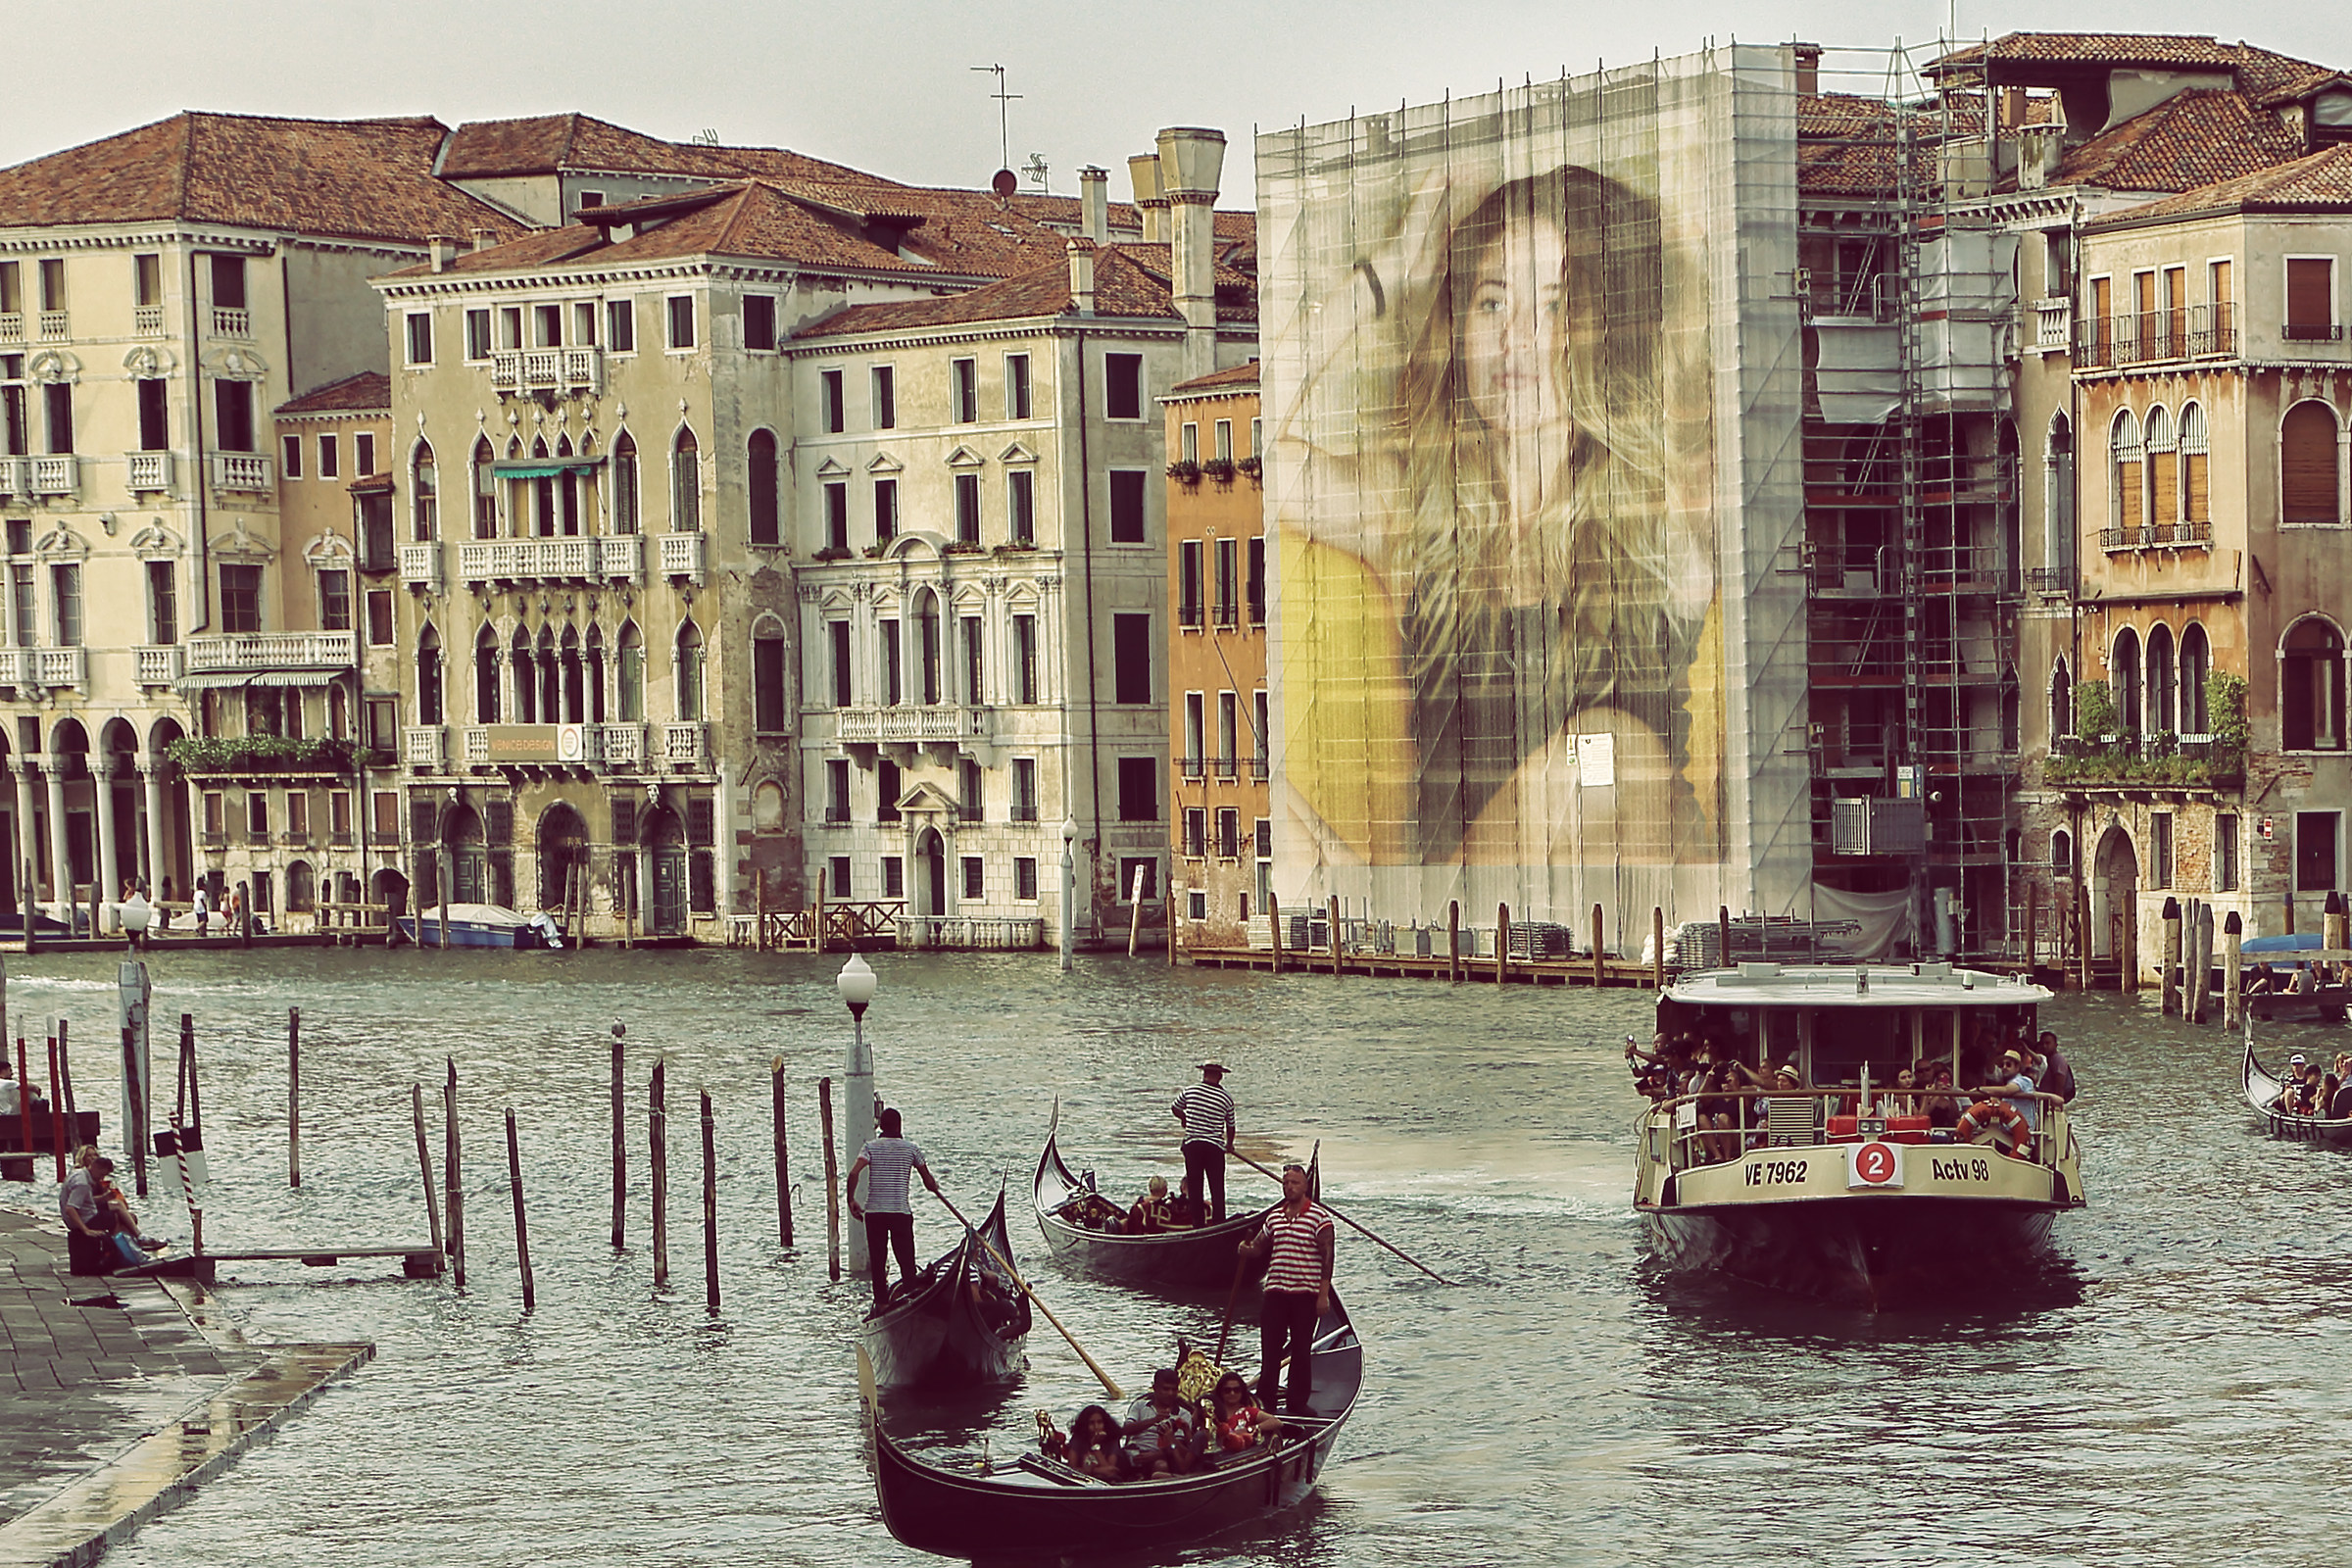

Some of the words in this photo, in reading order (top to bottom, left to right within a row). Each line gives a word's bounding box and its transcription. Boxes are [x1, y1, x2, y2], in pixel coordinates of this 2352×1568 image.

[1745, 1163, 1762, 1186] VE
[1767, 1160, 1808, 1185] 7962
[1868, 1152, 1884, 1174] 2
[1932, 1158, 1969, 1180] Actv
[1972, 1158, 1989, 1182] 98
